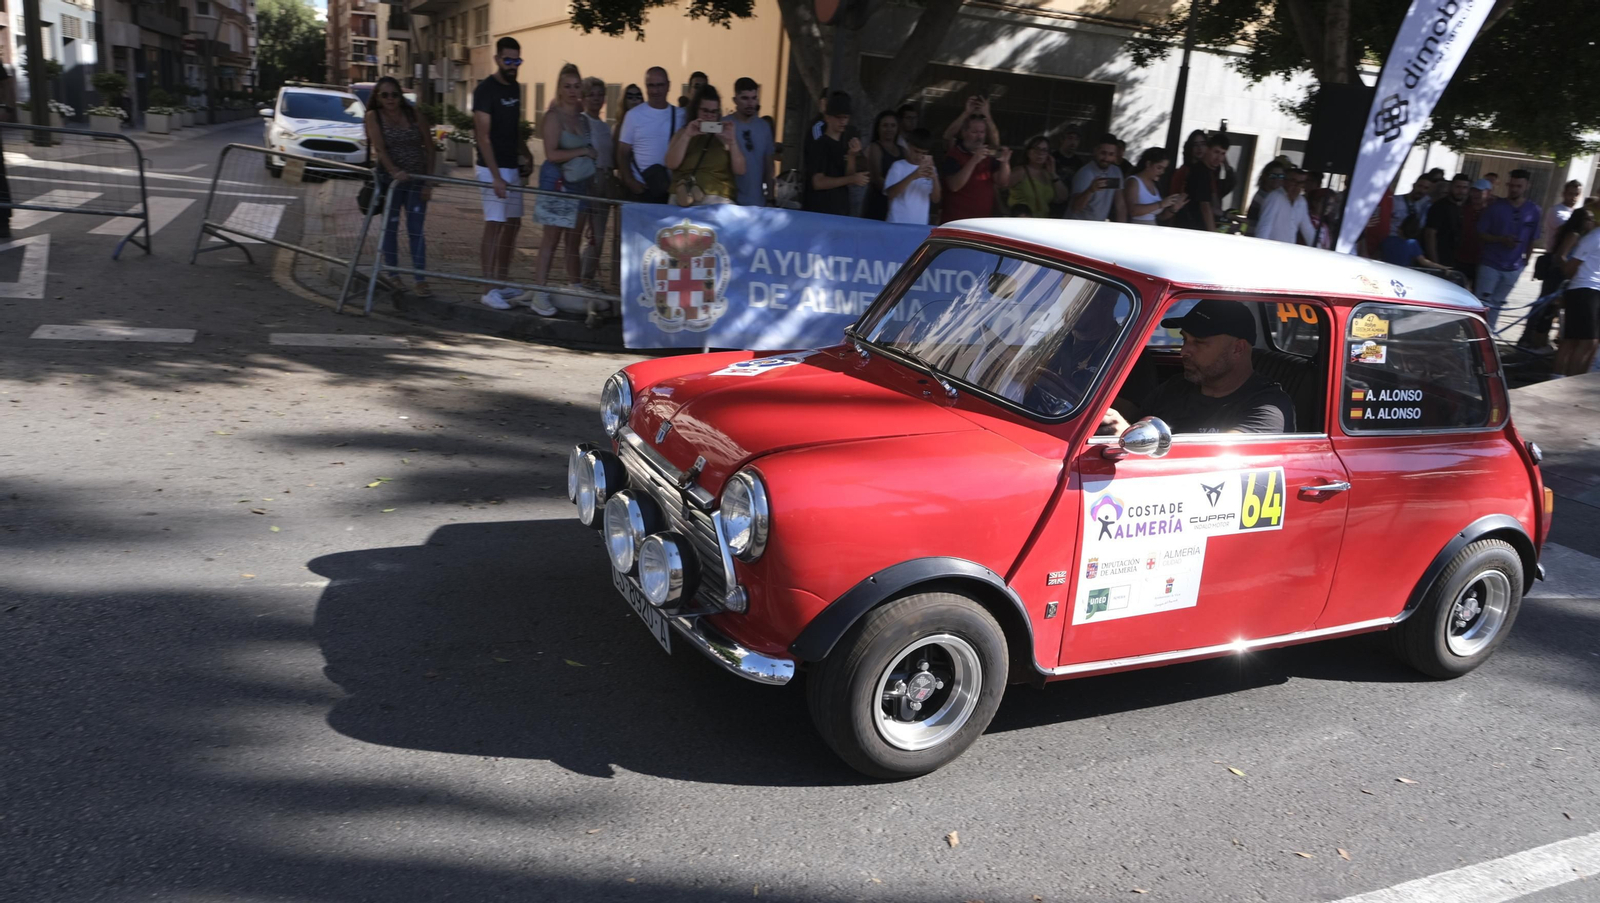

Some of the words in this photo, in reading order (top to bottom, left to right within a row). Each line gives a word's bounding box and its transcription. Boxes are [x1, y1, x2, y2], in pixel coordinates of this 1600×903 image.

[748, 281, 789, 310] DE
[797, 286, 928, 323] ALMEIA
[1366, 389, 1377, 401] A.
[1379, 389, 1423, 402] ALONSO
[1364, 408, 1375, 420] A.
[1377, 407, 1422, 420] ALONSO
[1241, 471, 1282, 528] 64
[1127, 504, 1167, 518] COSTA
[1169, 502, 1184, 514] DE
[1189, 512, 1236, 524] CUPRA
[1114, 514, 1183, 540] ALMERÍA
[1163, 546, 1201, 559] ALMERÍA
[1101, 557, 1140, 570] DIPUTACIÓN
[1100, 569, 1110, 577] DE
